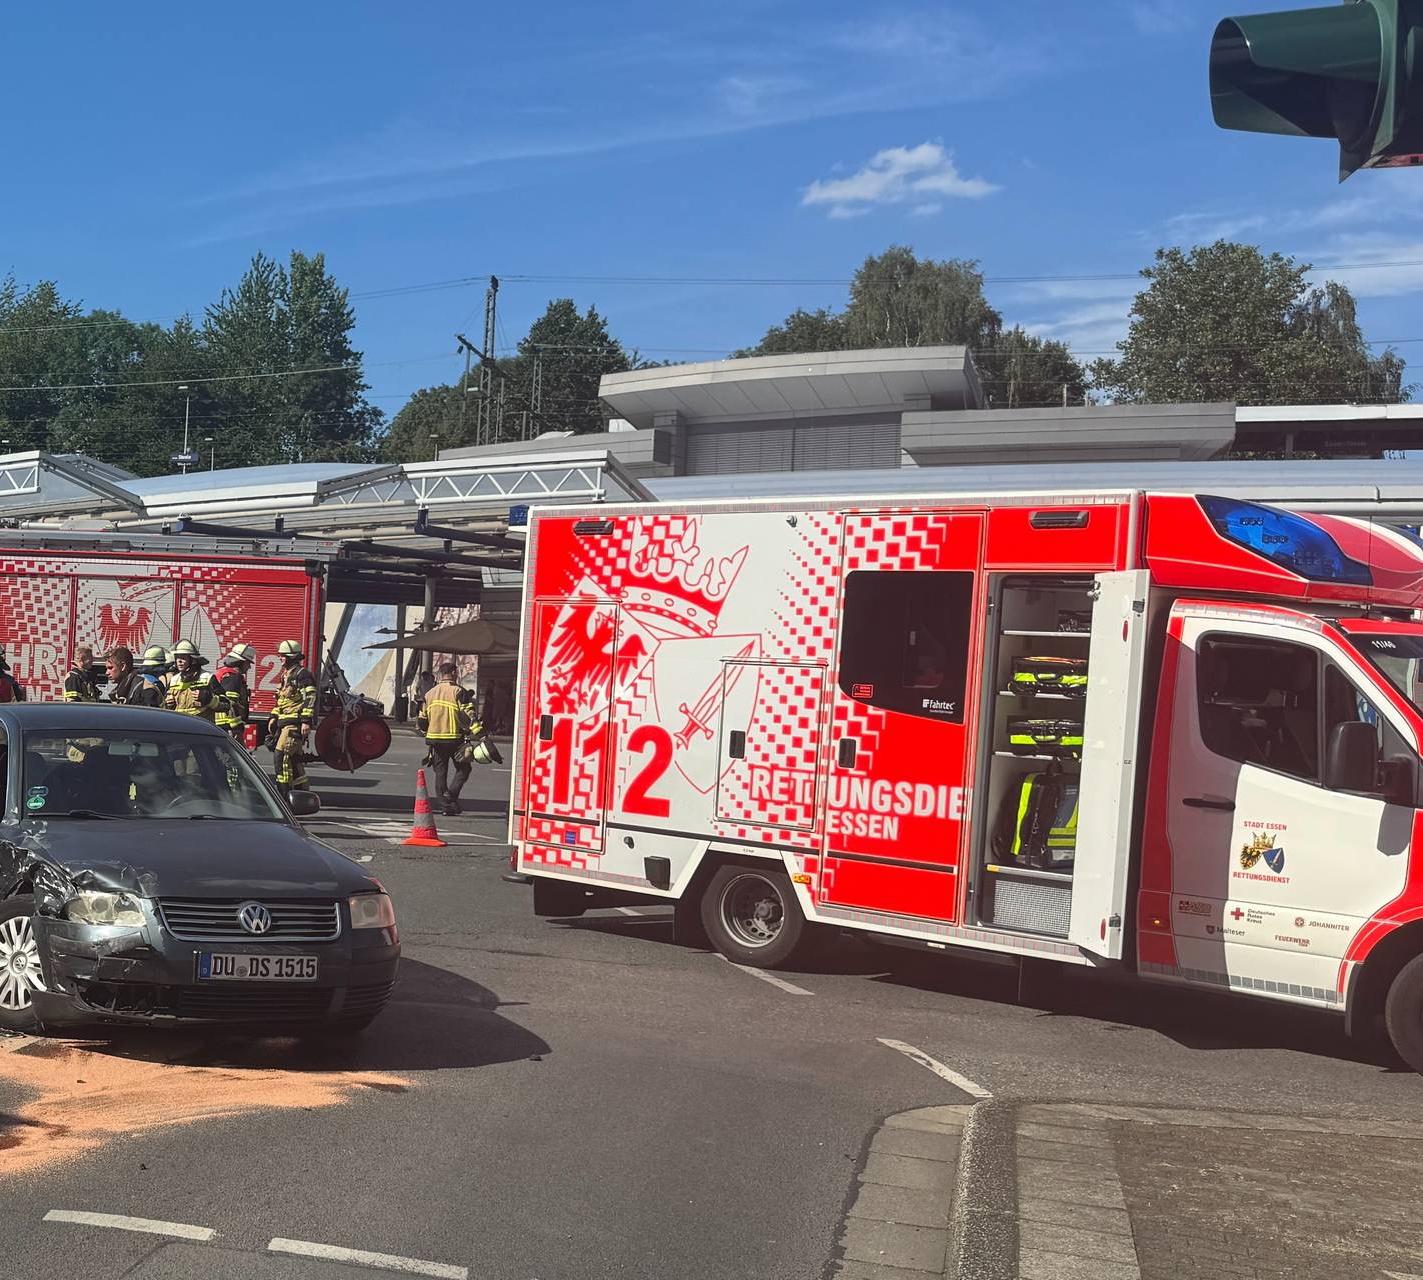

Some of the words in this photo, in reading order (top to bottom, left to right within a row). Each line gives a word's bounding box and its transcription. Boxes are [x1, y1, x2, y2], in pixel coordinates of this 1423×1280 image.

[540, 718, 674, 818] 112
[827, 810, 899, 841] ESSEN
[1243, 820, 1264, 829] STADT
[1266, 822, 1288, 831] ESSEN
[1233, 871, 1290, 884] RETTUNGSDIENST
[1216, 926, 1245, 937] Malteser
[1308, 920, 1350, 932] JOHANNITER
[212, 956, 235, 976] DU
[248, 957, 271, 977] DS
[274, 958, 316, 978] 1515
